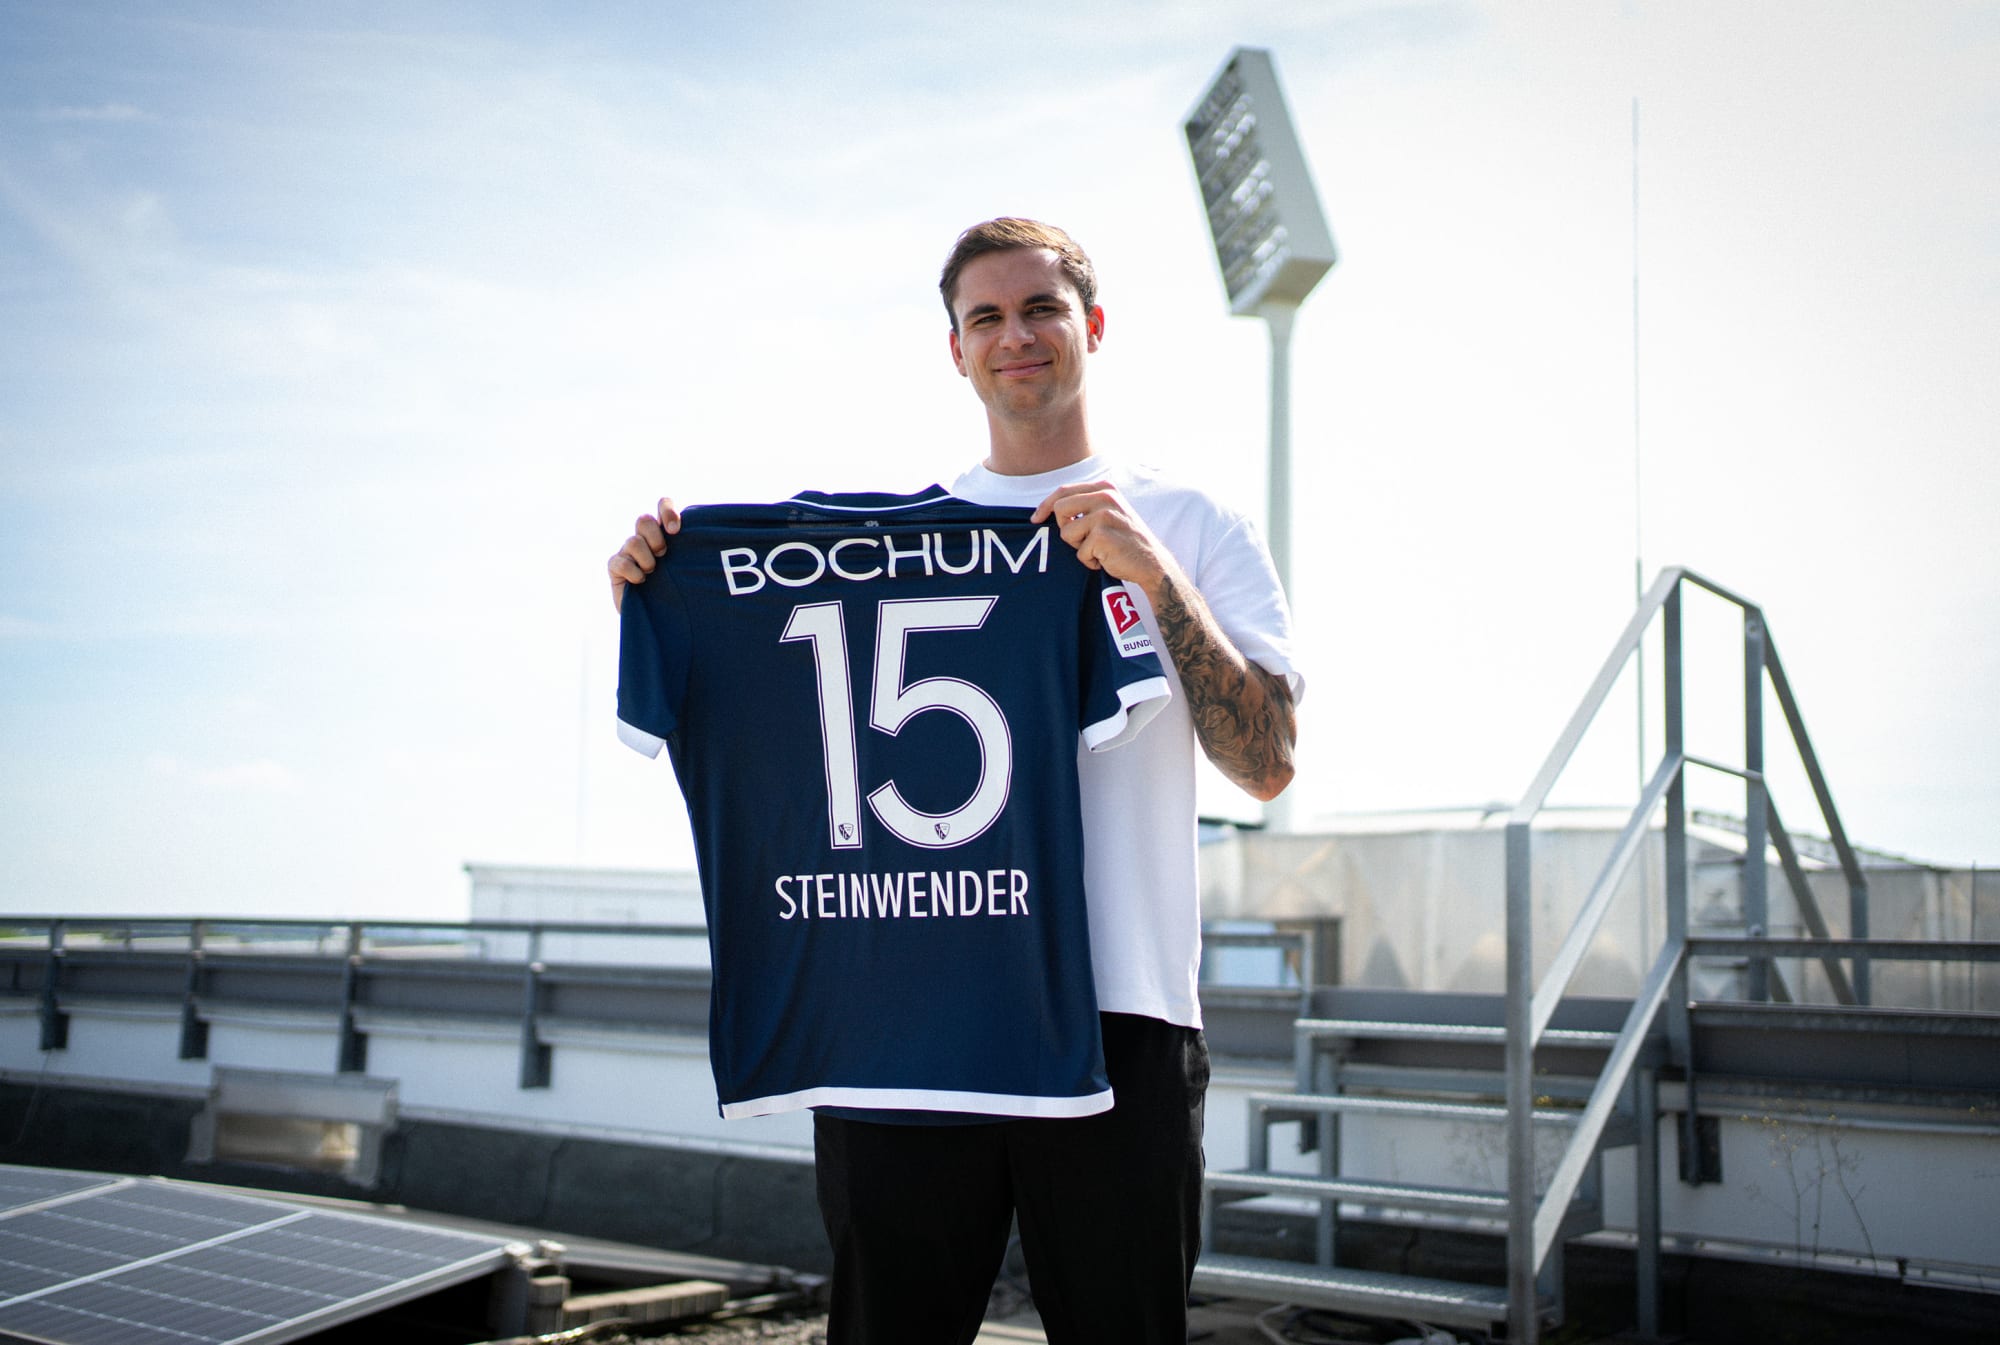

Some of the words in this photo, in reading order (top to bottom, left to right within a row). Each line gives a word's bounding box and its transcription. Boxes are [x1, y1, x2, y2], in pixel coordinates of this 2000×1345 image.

[720, 527, 1049, 595] BOCHUM
[779, 596, 1012, 849] 15
[775, 869, 1029, 919] STEINWENDER
